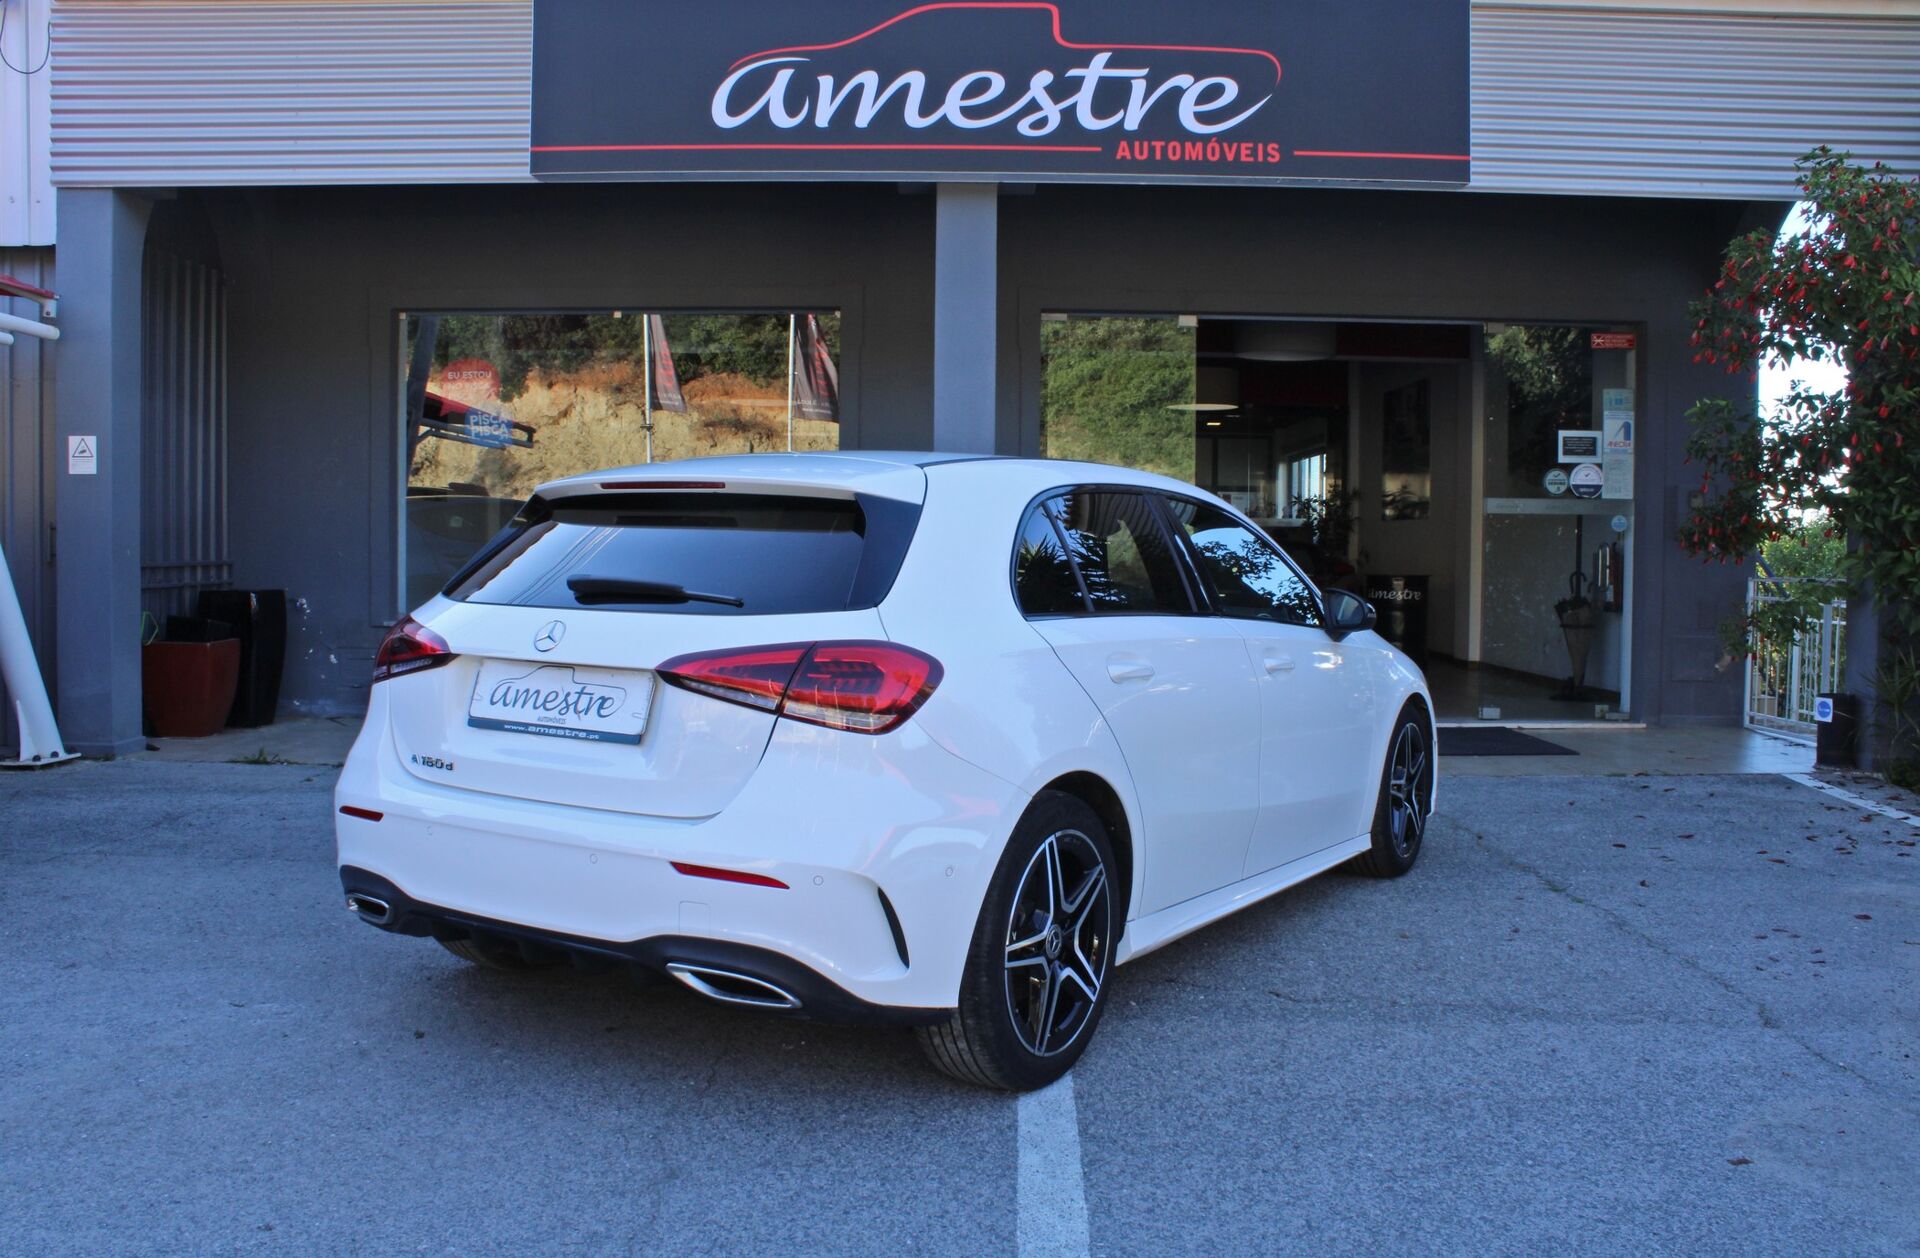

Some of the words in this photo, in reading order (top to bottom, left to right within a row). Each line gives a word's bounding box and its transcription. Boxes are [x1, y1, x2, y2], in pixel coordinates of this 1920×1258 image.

[711, 52, 1272, 137] amestre
[1115, 137, 1281, 163] AUTOMÓVEIS
[463, 370, 491, 378] ESTOU
[489, 681, 616, 719] amestre
[503, 724, 600, 740] www.amestre.pt
